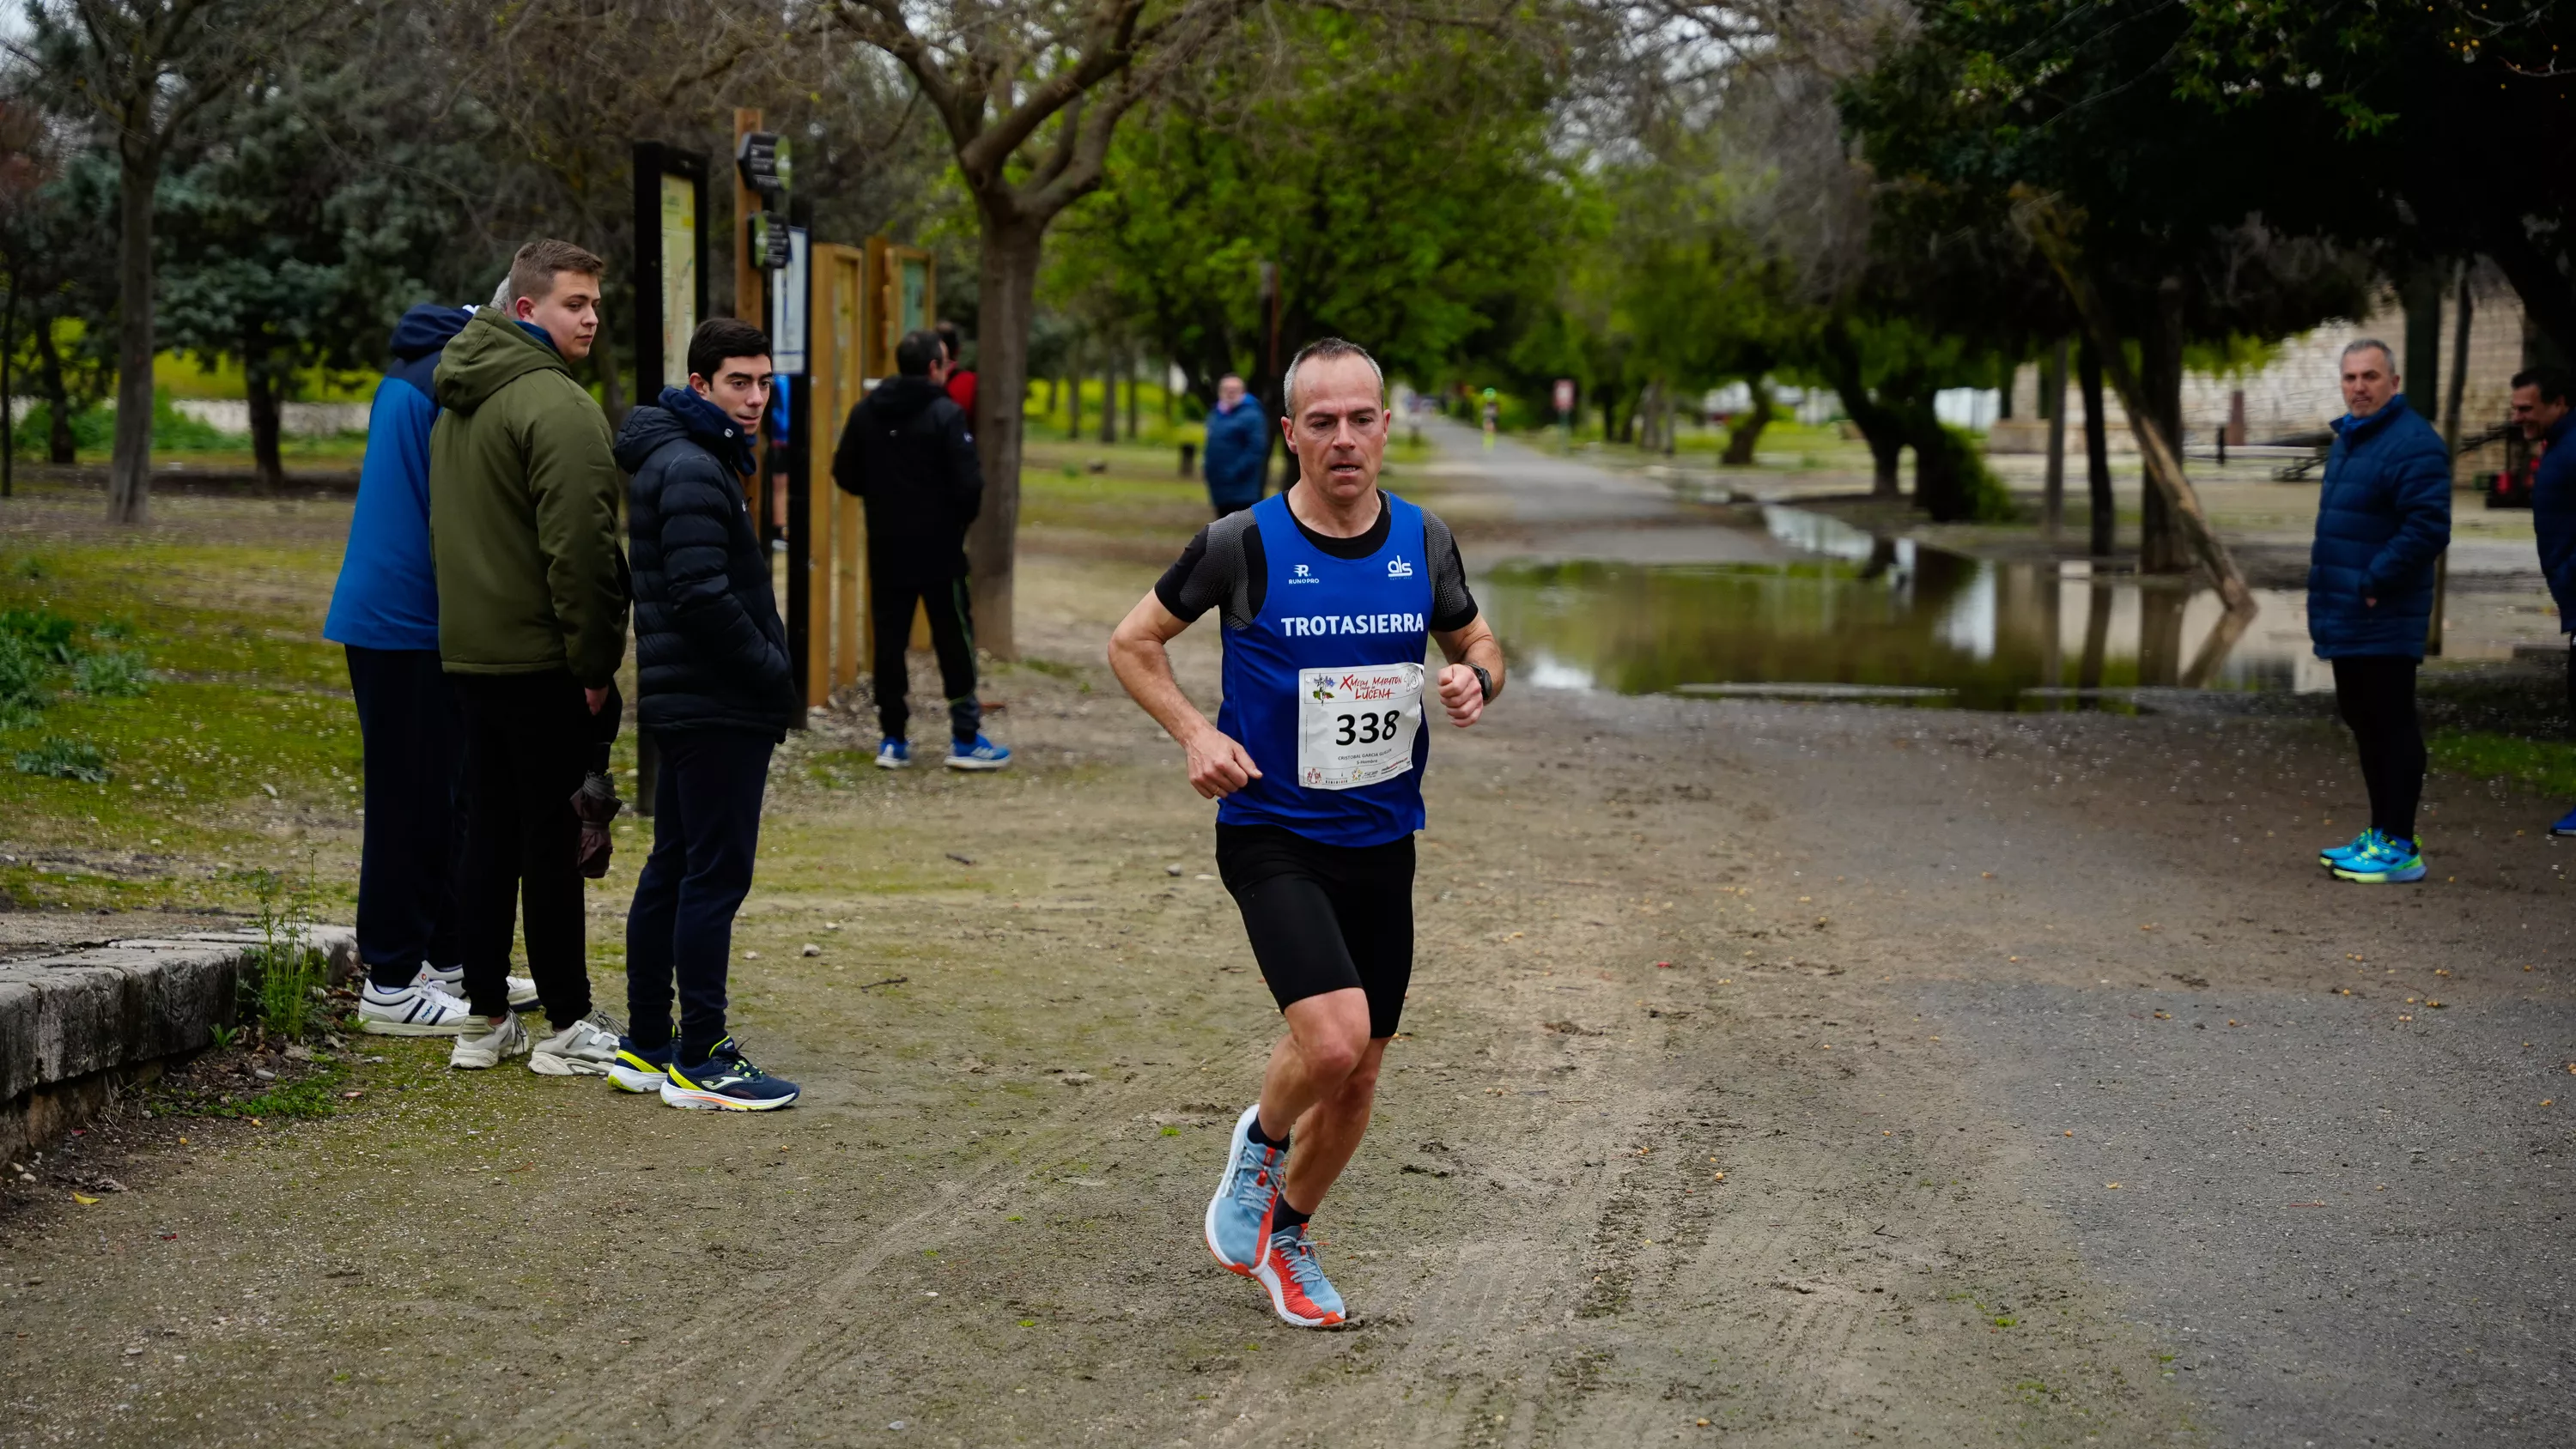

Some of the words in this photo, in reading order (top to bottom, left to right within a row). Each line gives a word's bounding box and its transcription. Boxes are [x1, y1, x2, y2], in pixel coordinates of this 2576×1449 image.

[1388, 555, 1413, 577] als
[1280, 612, 1425, 637] TROTASIERRA
[1355, 688, 1395, 700] LUCENA
[1335, 710, 1400, 746] 338
